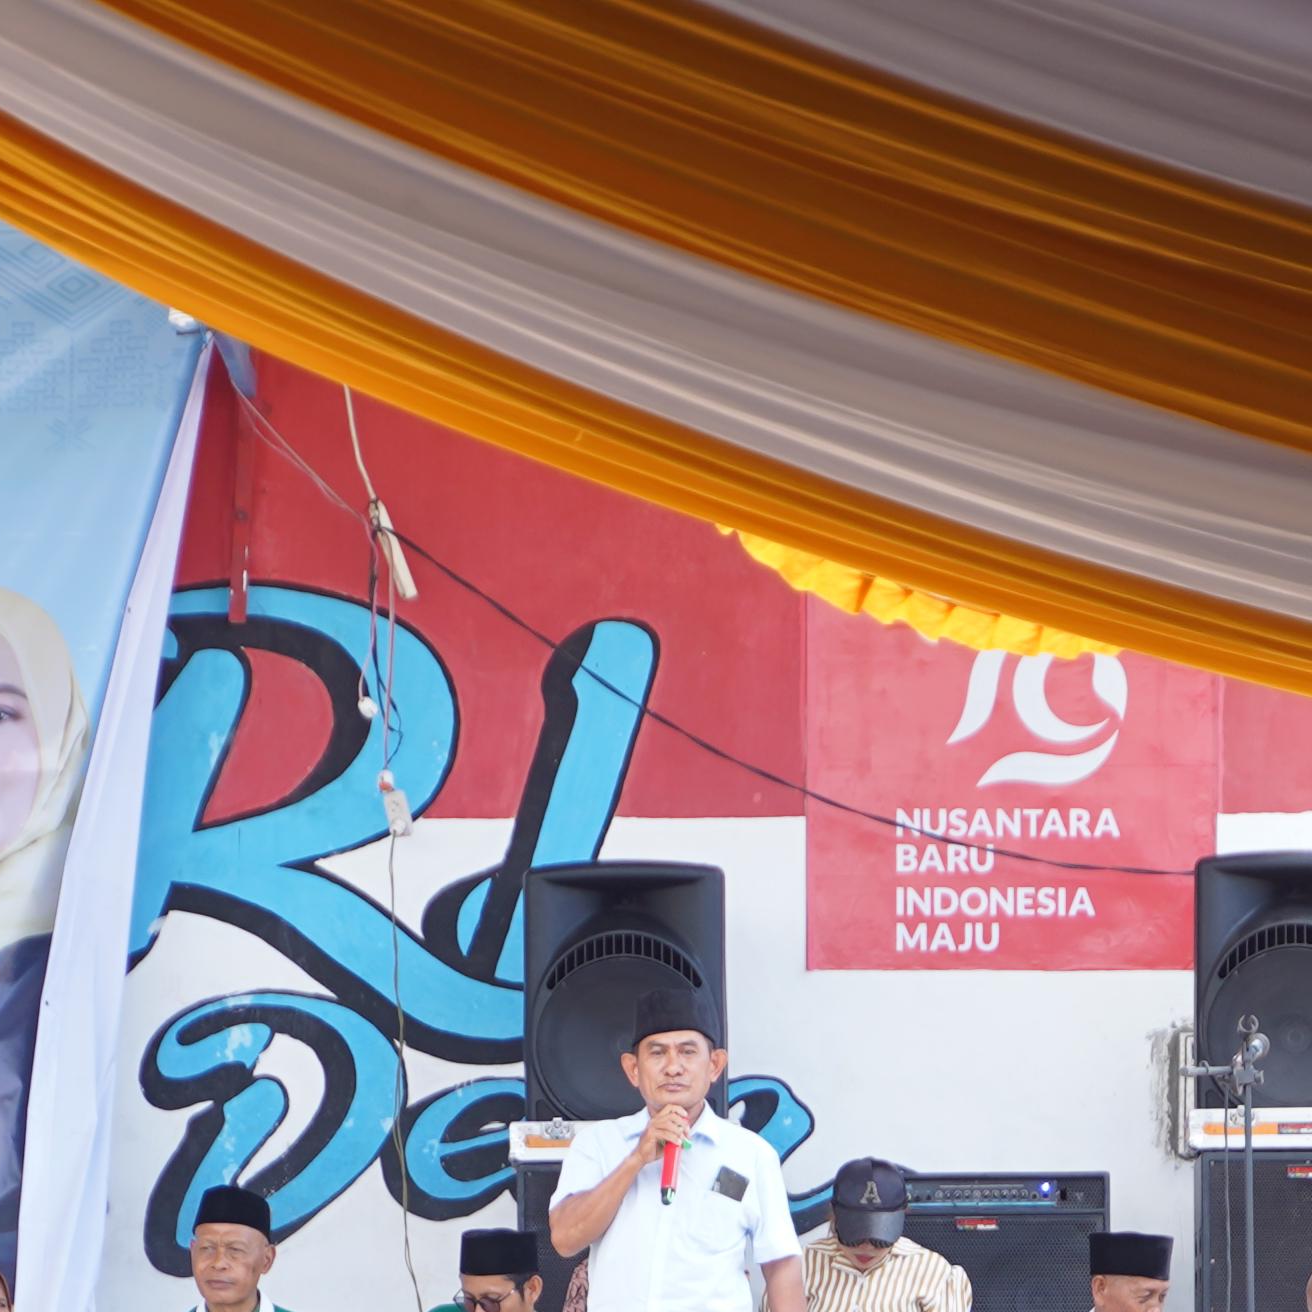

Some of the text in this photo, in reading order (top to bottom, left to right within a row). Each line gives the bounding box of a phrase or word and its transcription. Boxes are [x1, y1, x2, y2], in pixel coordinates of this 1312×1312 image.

[895, 807, 1121, 838] NUSANTARA
[895, 843, 995, 873] BARU
[895, 886, 1096, 917] INDONESIA
[895, 922, 1000, 952] MAJU
[860, 1181, 881, 1204] A
